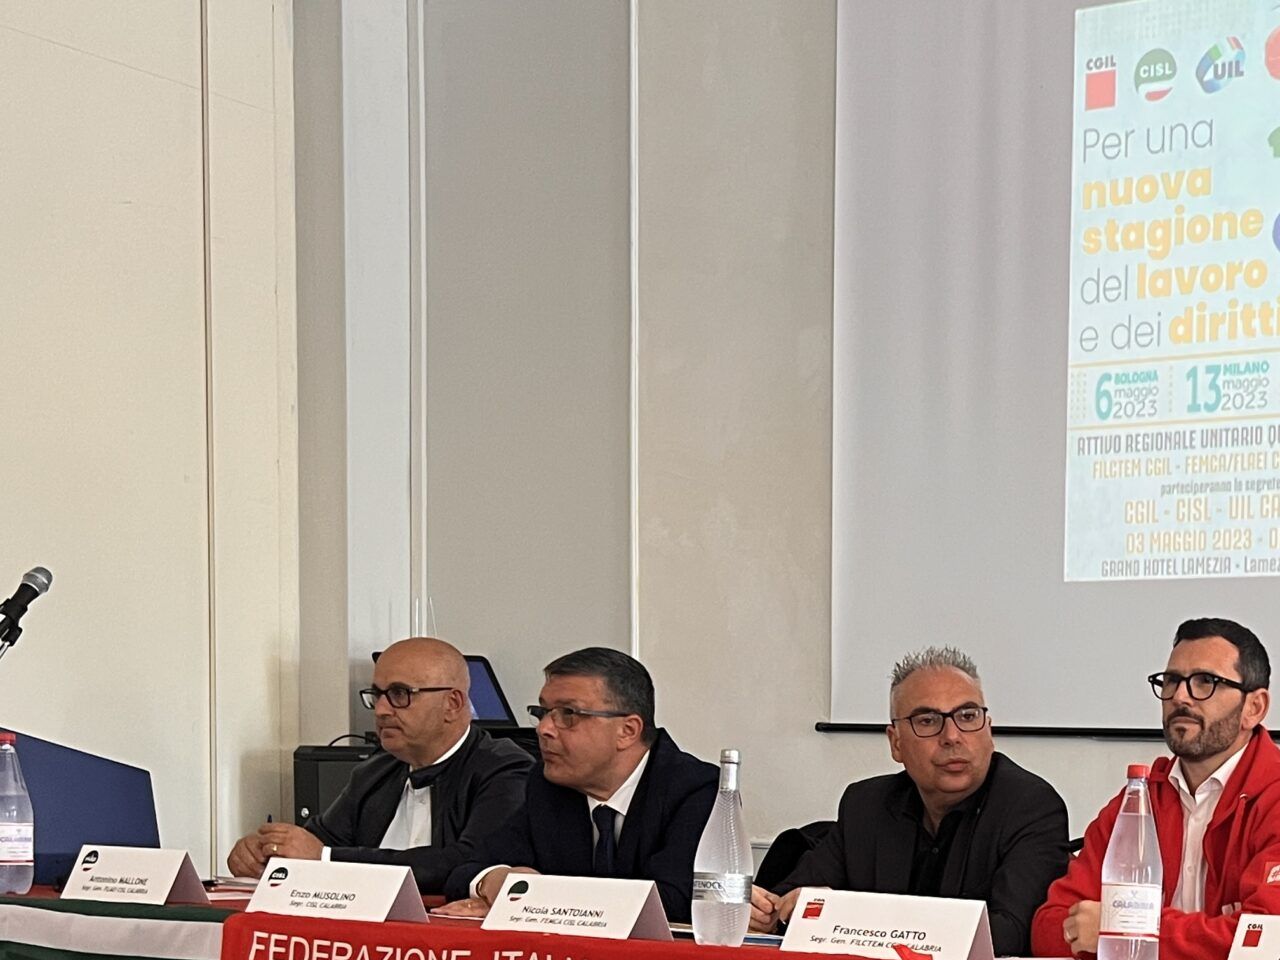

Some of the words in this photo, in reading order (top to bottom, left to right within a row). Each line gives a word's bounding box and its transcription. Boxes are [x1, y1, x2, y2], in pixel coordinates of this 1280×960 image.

[1086, 55, 1117, 71] CGIL
[1139, 61, 1172, 78] CISL
[1213, 60, 1244, 81] UIL
[1083, 127, 1135, 163] Per
[1146, 119, 1214, 154] una
[1082, 167, 1212, 210] nuova
[1083, 205, 1264, 260] stagione
[1080, 264, 1128, 305] del
[1136, 259, 1268, 299] lavoro
[1079, 325, 1099, 352] e
[1111, 311, 1162, 350] dei
[1114, 369, 1158, 384] BOLOGNA
[1223, 360, 1269, 376] MILANO
[1114, 384, 1159, 402] maggio
[1186, 364, 1222, 413] 13
[1222, 374, 1270, 394] maggio
[1095, 372, 1113, 420] 6
[1220, 390, 1268, 411] 2023
[1112, 400, 1158, 420] 2023
[1077, 434, 1121, 456] ATTIVO
[1125, 430, 1196, 453] REGIONALE
[1201, 426, 1263, 449] UNITARIO
[1093, 458, 1142, 479] FILCTEM
[1145, 457, 1173, 476] CGIL
[1185, 451, 1268, 475] FEMCA/FLAEI
[1125, 500, 1159, 524] CGIL
[1176, 497, 1212, 522] CISL
[1228, 495, 1254, 520] UIL
[1126, 532, 1145, 554] 03
[1150, 530, 1207, 553] MAGGIO
[1212, 528, 1252, 551] 2023
[1101, 559, 1140, 577] GRAND
[1143, 557, 1178, 576] HOTEL
[1182, 556, 1231, 575] LAMEZIA
[290, 889, 311, 899] Enzo
[312, 892, 356, 902] MUSOLINO
[522, 906, 549, 915] Nicola
[550, 907, 604, 918] SANTOIANNI
[832, 925, 887, 938] Francesco
[890, 929, 927, 941] GATTO
[849, 939, 884, 948] FILCTEM
